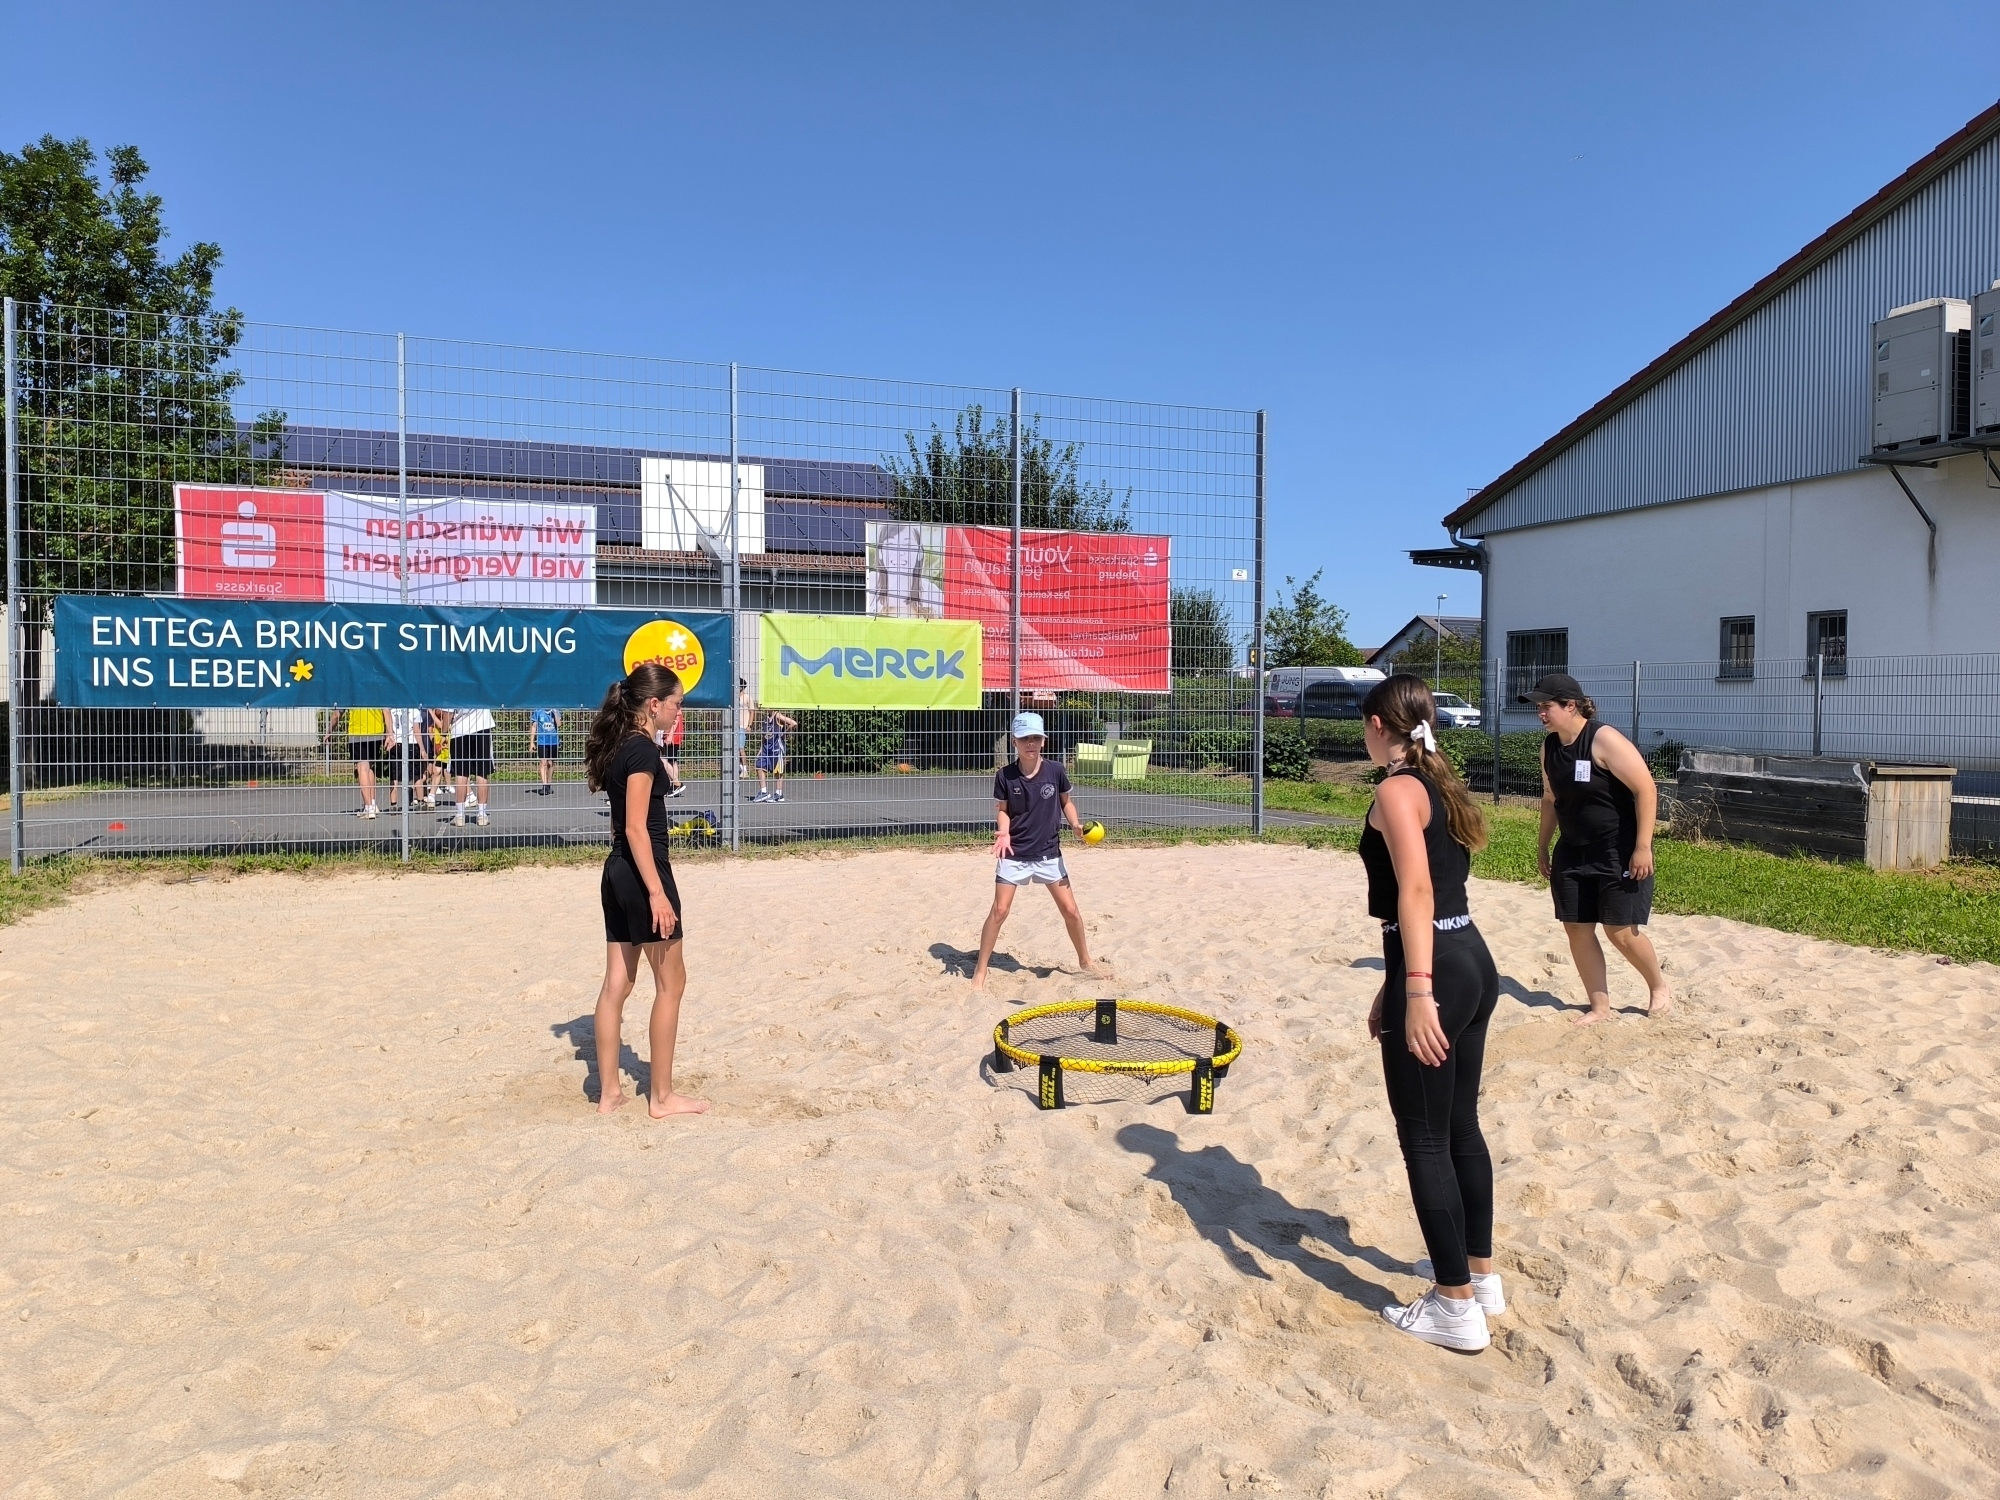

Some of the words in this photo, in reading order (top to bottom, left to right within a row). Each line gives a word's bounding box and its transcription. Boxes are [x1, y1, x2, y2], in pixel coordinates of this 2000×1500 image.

[92, 616, 243, 648] ENTEGA
[256, 620, 387, 650] BRINGT
[398, 622, 576, 654] STIMMUNG
[93, 657, 154, 687] INS
[169, 658, 291, 688] LEBEN.
[1041, 1073, 1049, 1109] SPIKE
[1047, 1079, 1056, 1108] BALL
[1199, 1076, 1207, 1111] SPIKE
